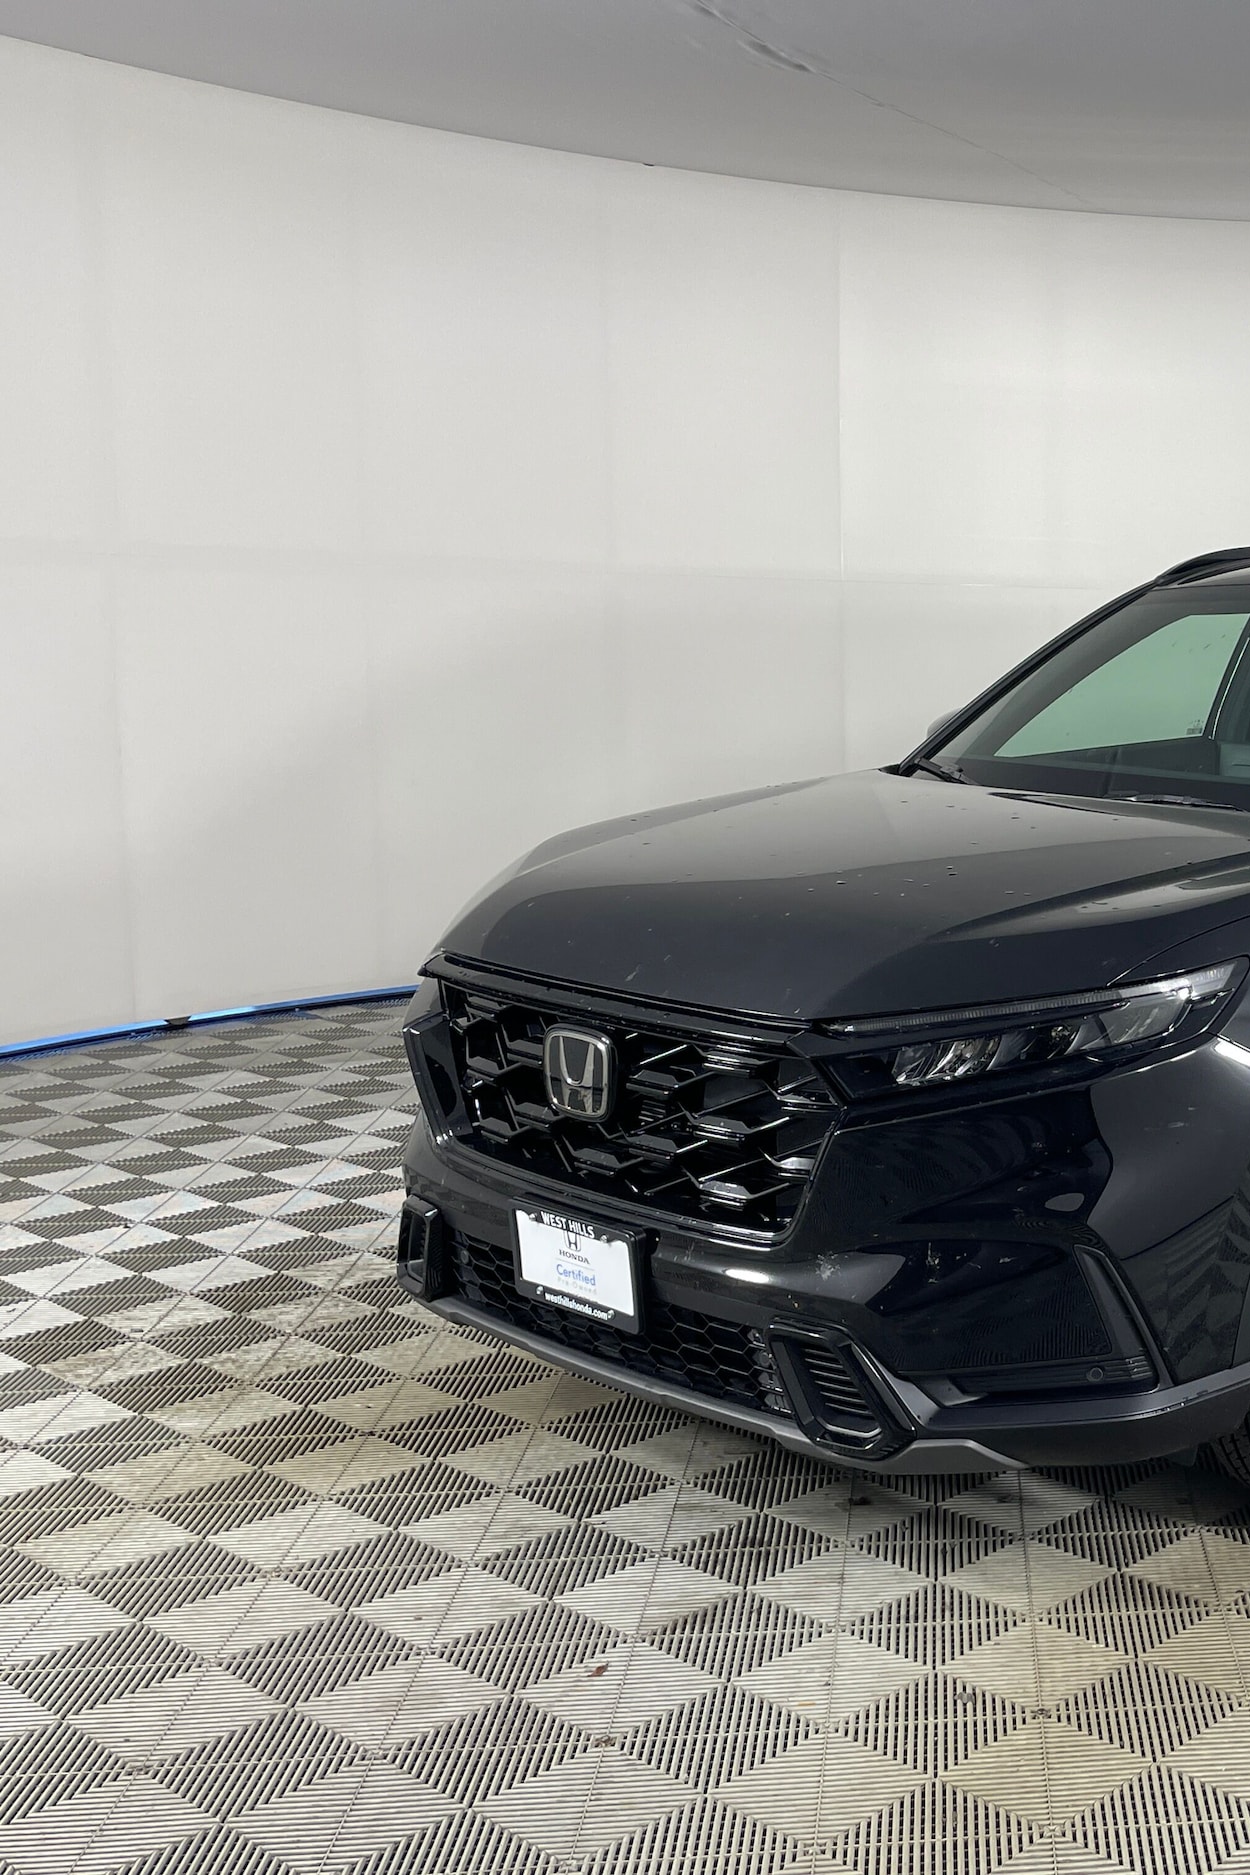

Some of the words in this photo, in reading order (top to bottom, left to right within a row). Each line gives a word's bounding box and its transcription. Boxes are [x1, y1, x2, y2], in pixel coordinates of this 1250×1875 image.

[541, 1211, 566, 1229] WEST
[568, 1220, 595, 1238] HILLS
[559, 1249, 590, 1264] HONDA
[556, 1264, 596, 1286] Certified
[545, 1292, 608, 1320] westhillshonda.com
